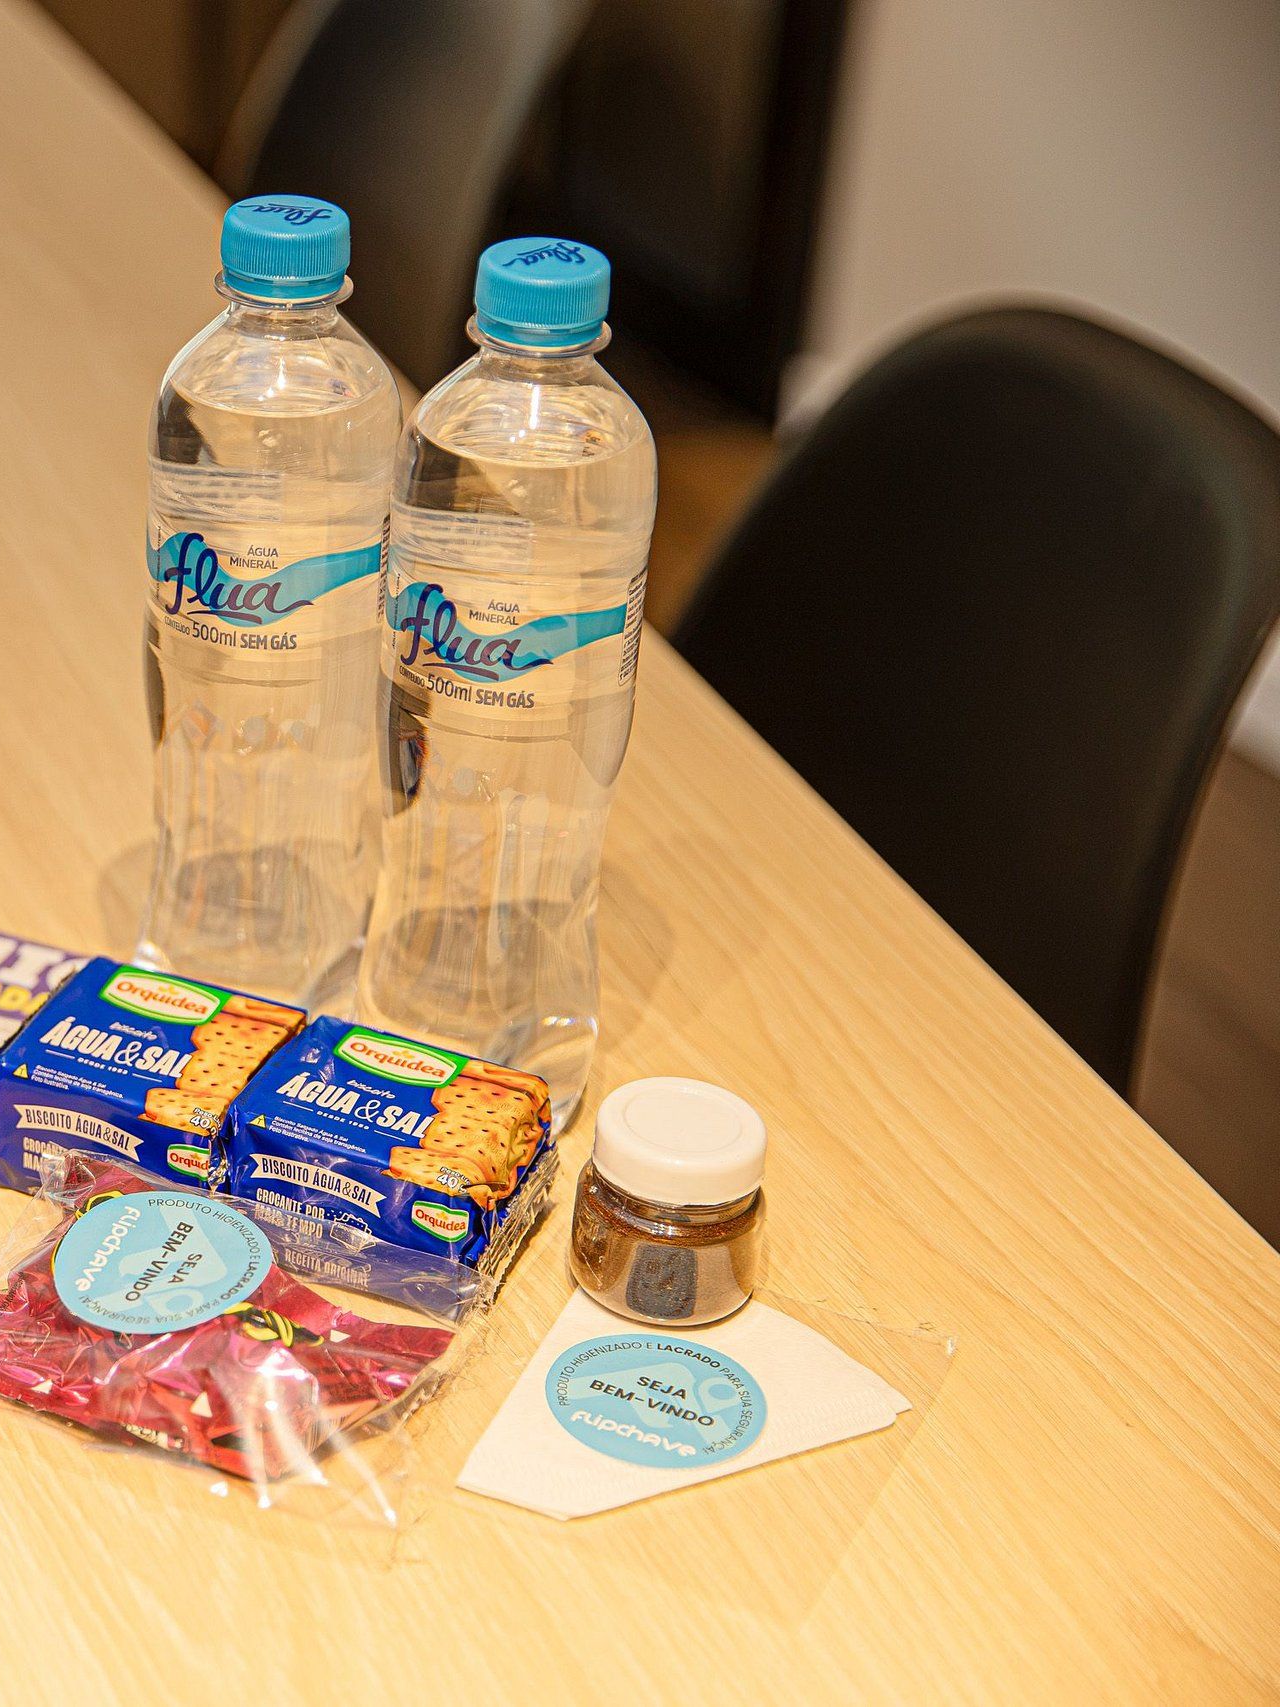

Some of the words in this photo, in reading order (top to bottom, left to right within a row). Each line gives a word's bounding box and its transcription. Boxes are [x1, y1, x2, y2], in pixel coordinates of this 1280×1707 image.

[229, 556, 279, 570] MINERAL
[247, 544, 279, 558] ÁGUA
[164, 532, 314, 617] flua
[469, 610, 520, 626] MINERAL
[488, 599, 520, 613] ÁGUA
[192, 621, 237, 647] 500ml
[240, 633, 268, 650] SEM
[270, 632, 298, 650] GÁS
[400, 583, 554, 671] flua
[426, 673, 471, 702] 500ml
[475, 688, 504, 706] SEM
[506, 690, 536, 709] GÁS
[25, 1107, 72, 1130] BISCOITO
[261, 1157, 310, 1183] BISCOITO
[437, 1174, 459, 1189] 40
[148, 1198, 212, 1215] PRODUTO
[256, 1187, 303, 1216] CROCANTE
[305, 1203, 326, 1221] POR
[214, 1211, 261, 1254] HIGIENIZADO
[286, 1212, 324, 1239] TEMPO
[125, 1221, 194, 1302] BEM-VINDO
[168, 1252, 203, 1284] SEJA
[285, 1248, 321, 1271] RECEITA
[220, 1260, 260, 1302] LACRADO
[557, 1366, 575, 1406] PRODUTO
[571, 1341, 642, 1368] HIGIENIZADO
[646, 1342, 653, 1350] E
[657, 1343, 721, 1368] LACRADO
[719, 1367, 742, 1390] PARA
[738, 1390, 753, 1409] SUA
[637, 1376, 687, 1400] SEJA
[589, 1379, 715, 1428] BEM-VINDO
